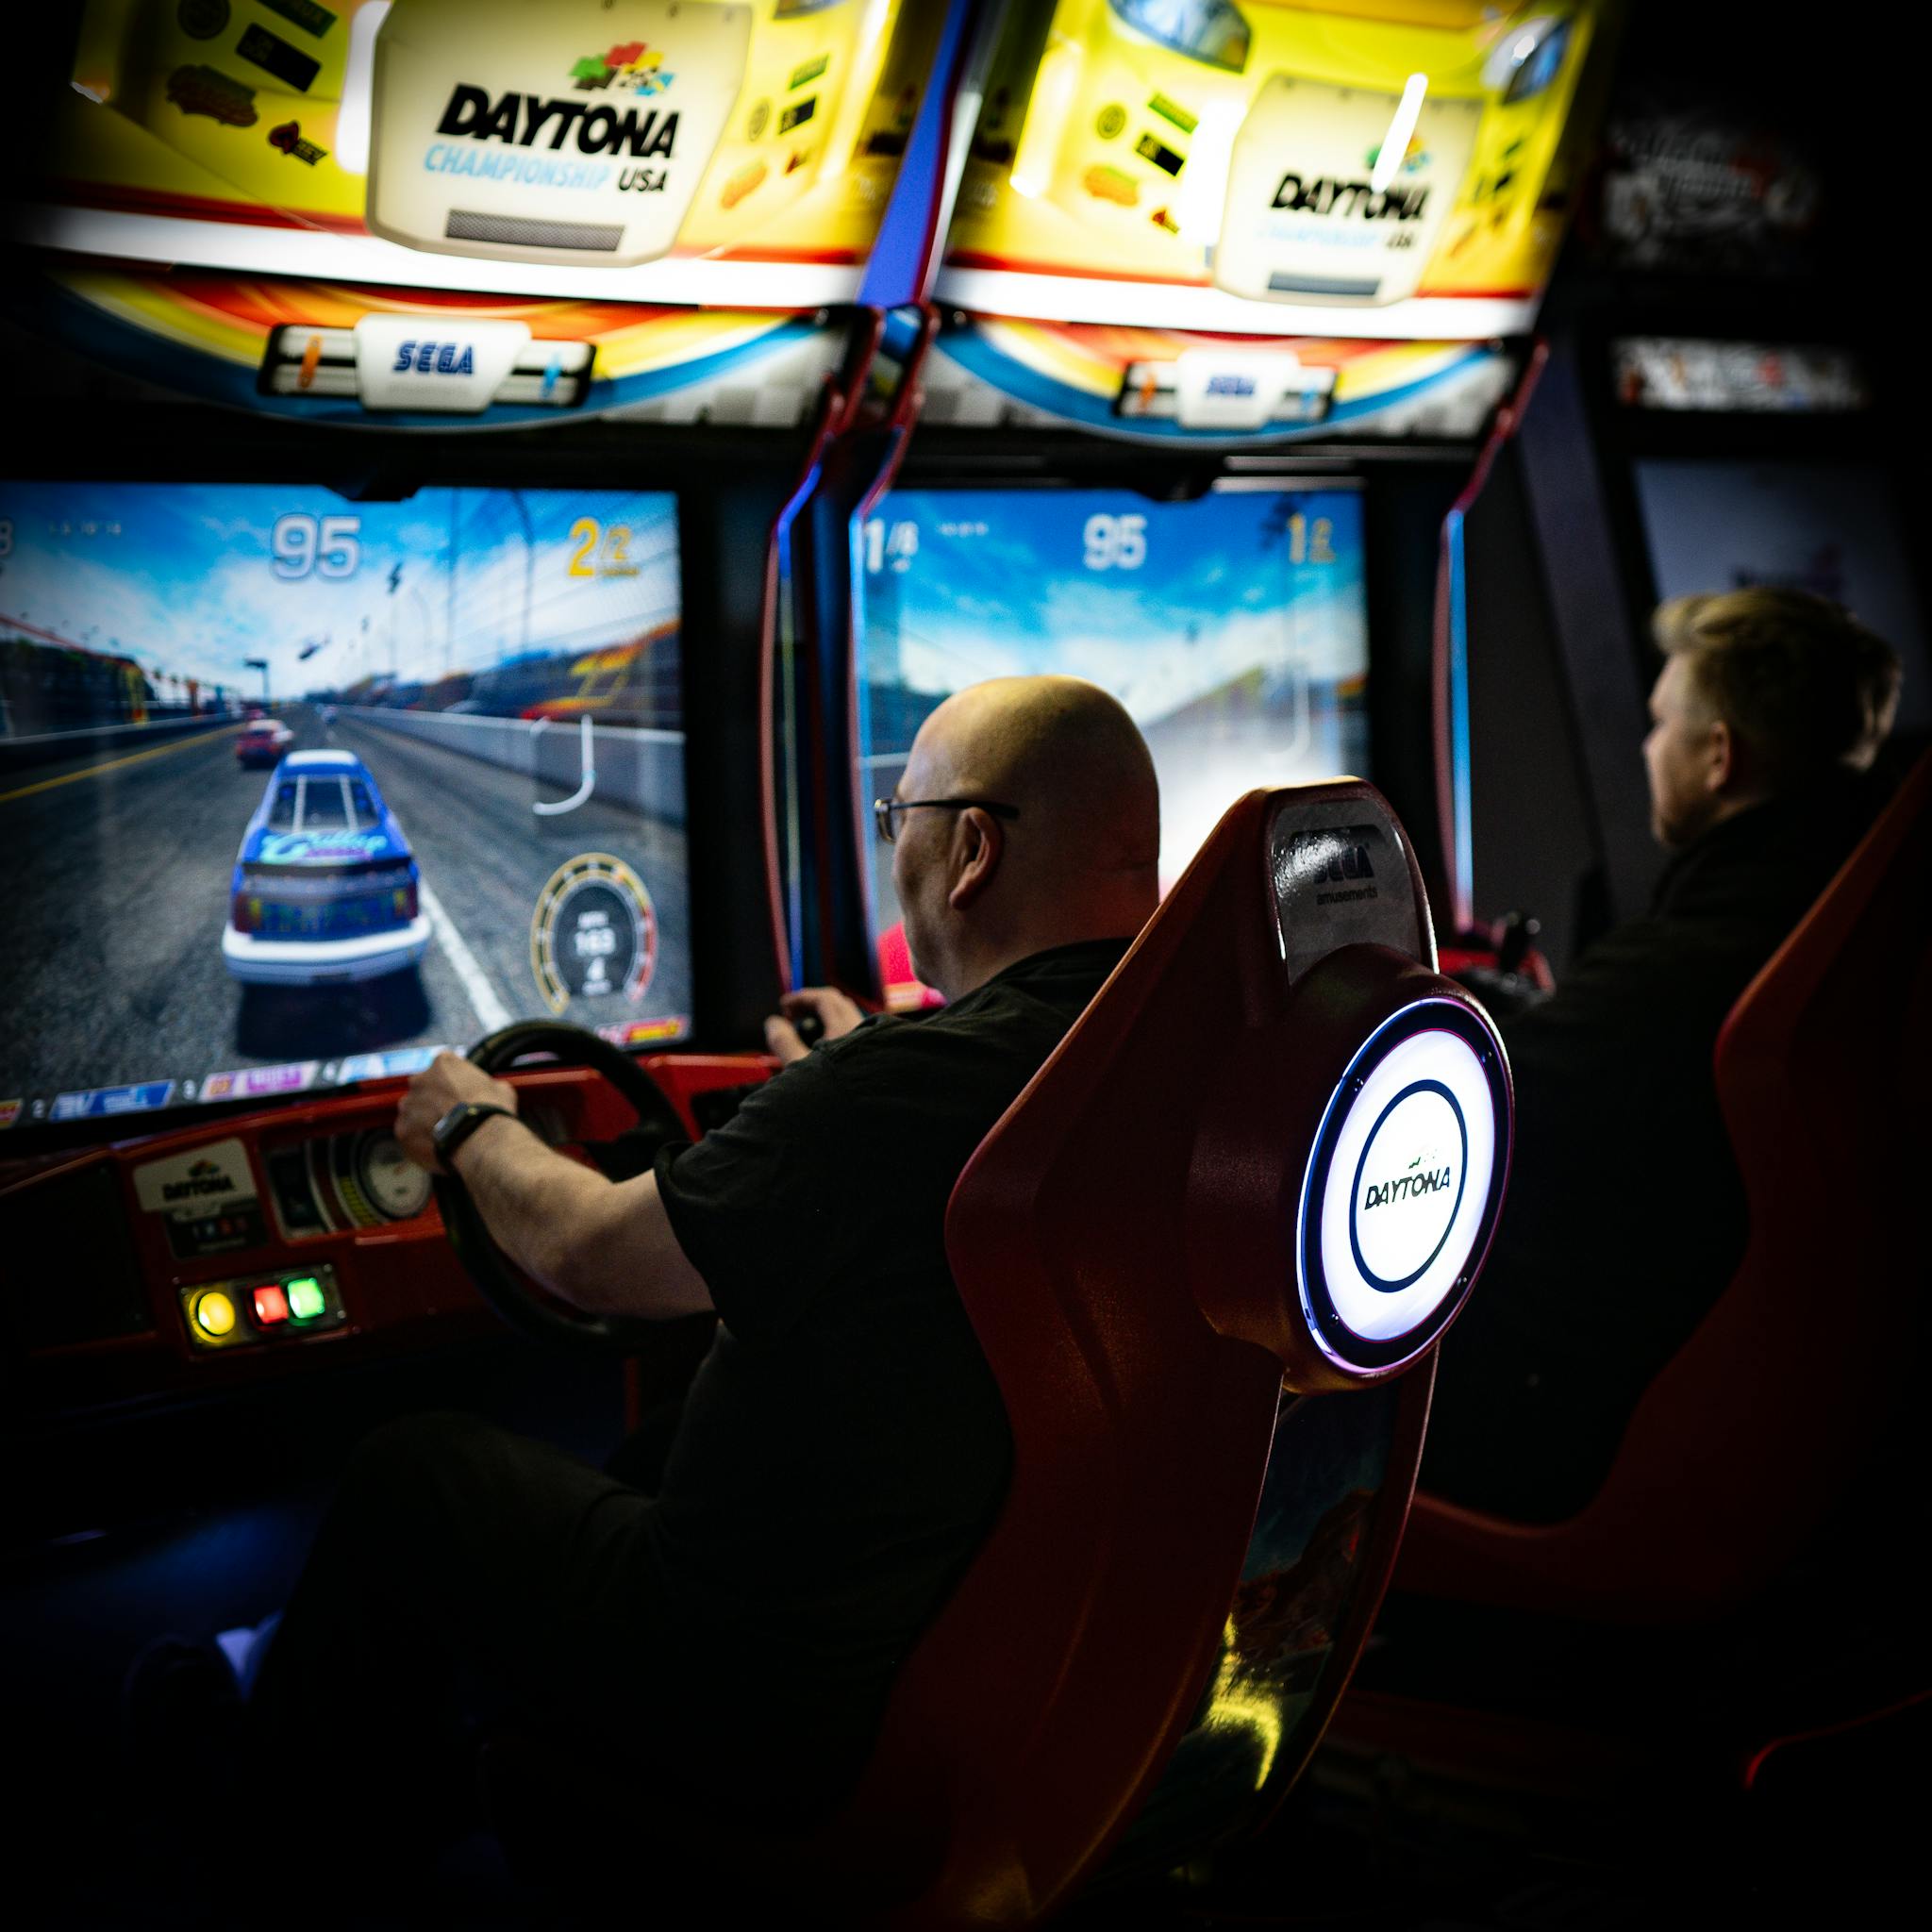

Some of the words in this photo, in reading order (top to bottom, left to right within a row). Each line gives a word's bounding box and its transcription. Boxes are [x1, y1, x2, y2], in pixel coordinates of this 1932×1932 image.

[437, 81, 679, 158] DAYTONA
[425, 143, 609, 189] CHAMPIONSHIP
[618, 166, 668, 192] USA
[1270, 174, 1429, 220] DAYTONA
[393, 340, 474, 374] SEGA
[271, 514, 361, 581] 95
[1084, 514, 1148, 571] 95
[1317, 885, 1378, 905] amusements
[1364, 1166, 1450, 1210] DAYTONA
